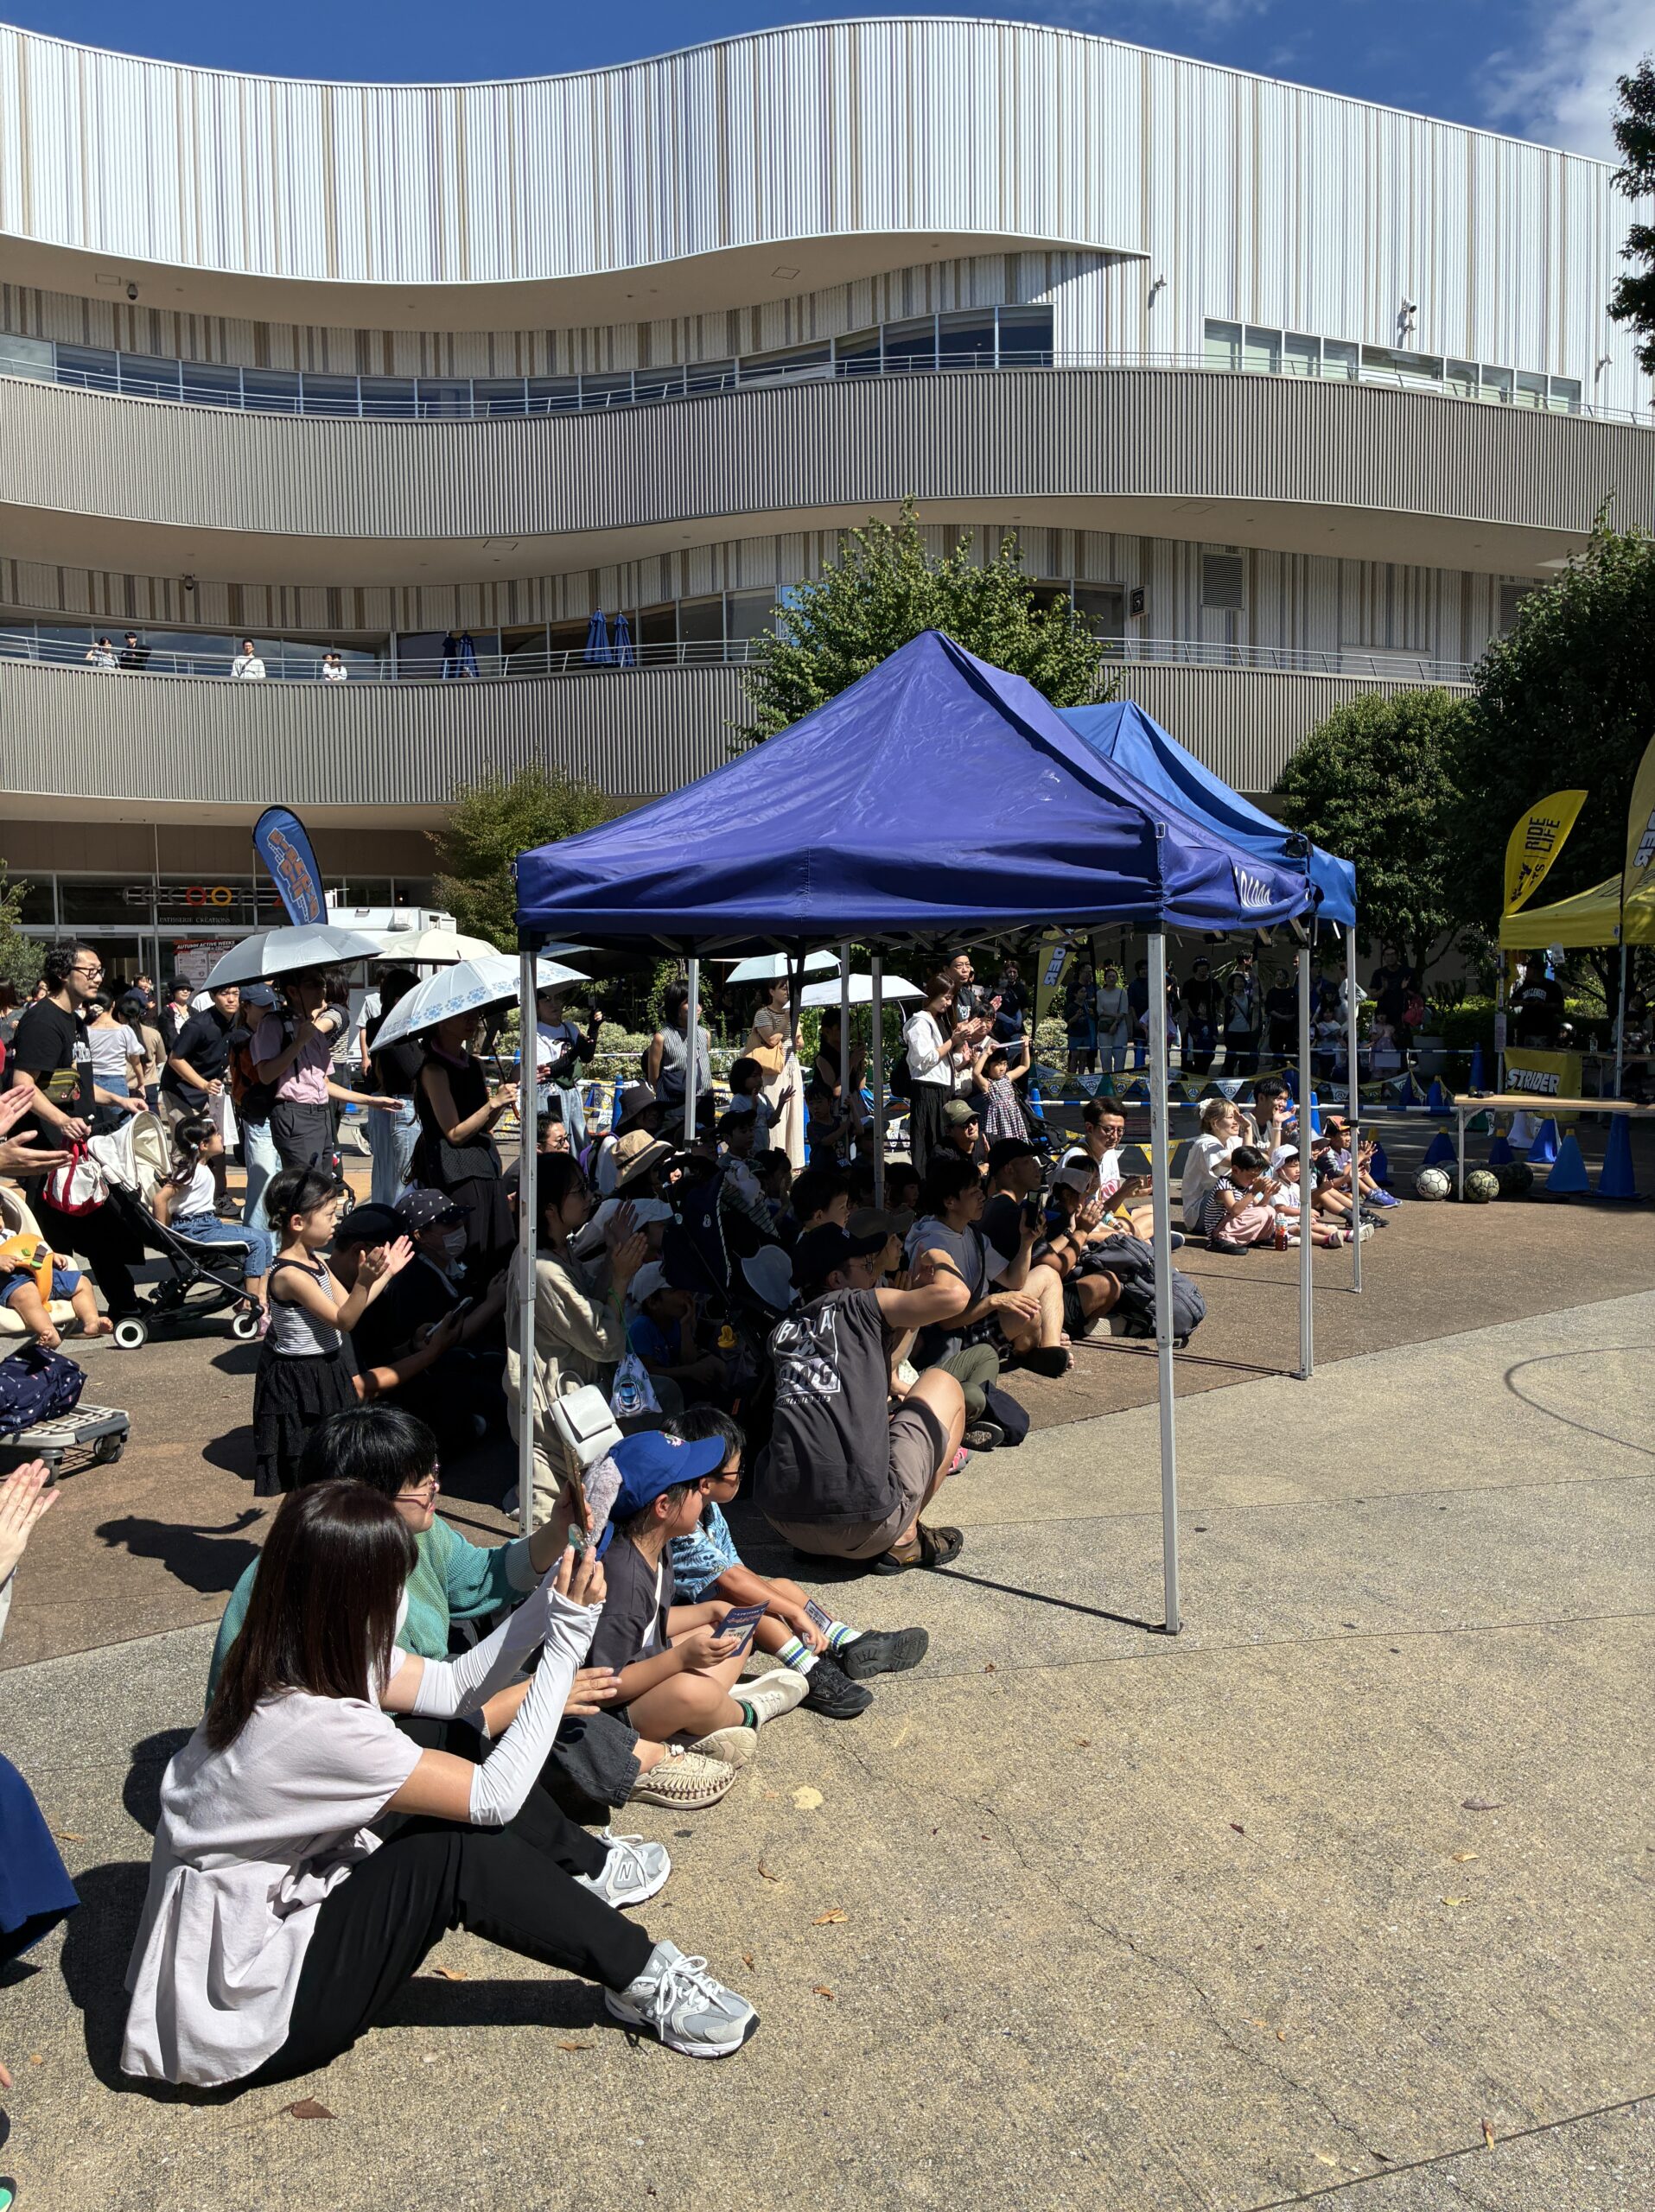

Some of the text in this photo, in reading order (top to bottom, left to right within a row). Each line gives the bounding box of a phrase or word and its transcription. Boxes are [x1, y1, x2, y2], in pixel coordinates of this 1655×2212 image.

[1525, 817, 1546, 851] RIDE
[1538, 818, 1561, 853] LIFE
[1506, 1067, 1561, 1096] STRIDER
